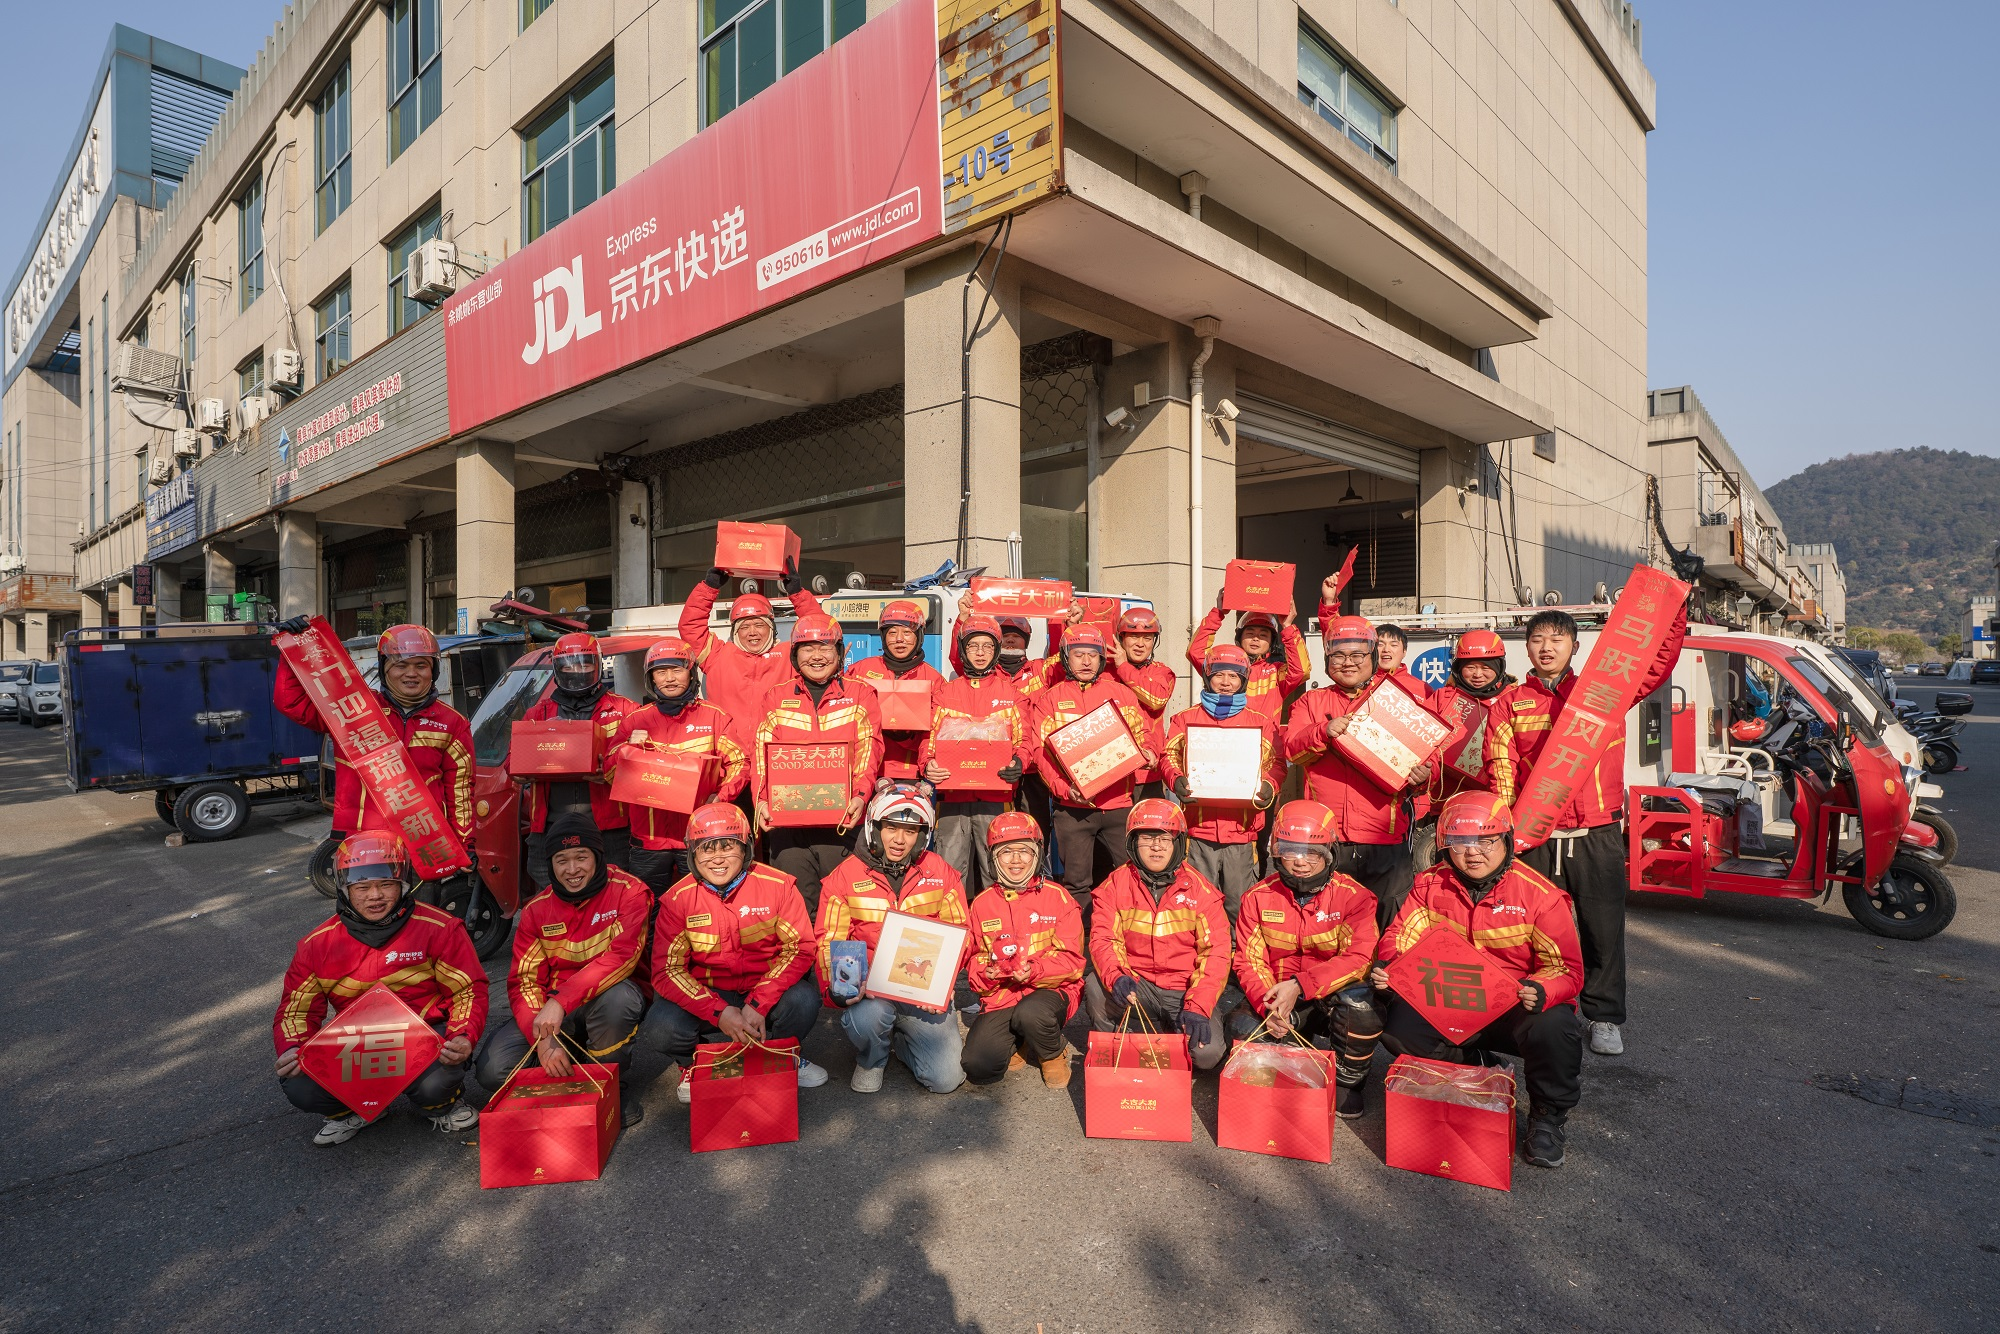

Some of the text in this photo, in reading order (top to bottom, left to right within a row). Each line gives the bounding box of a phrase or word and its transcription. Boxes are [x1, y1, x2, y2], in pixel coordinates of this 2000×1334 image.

[605, 217, 657, 259] Express
[775, 201, 914, 276] 950616 www.jdl.com
[608, 205, 749, 323] 京东快递
[447, 278, 503, 327] 余姚姚东营业部
[976, 589, 1064, 609] 大吉大利
[1419, 657, 1452, 684] 快
[1054, 705, 1113, 748] 大吉大利
[1059, 715, 1118, 754] GOOD LUCK
[1374, 694, 1437, 748] GOOD LUCK
[1379, 686, 1446, 741] 大吉大利
[1517, 614, 1655, 840] 马跃春风开泰运
[310, 661, 457, 868] 门迎福瑞起新程
[771, 746, 845, 760] 大吉大利
[771, 760, 845, 770] GOOD LUCK
[1417, 958, 1487, 1012] 福
[335, 1022, 410, 1082] 福
[1120, 1098, 1157, 1106] 大吉大利
